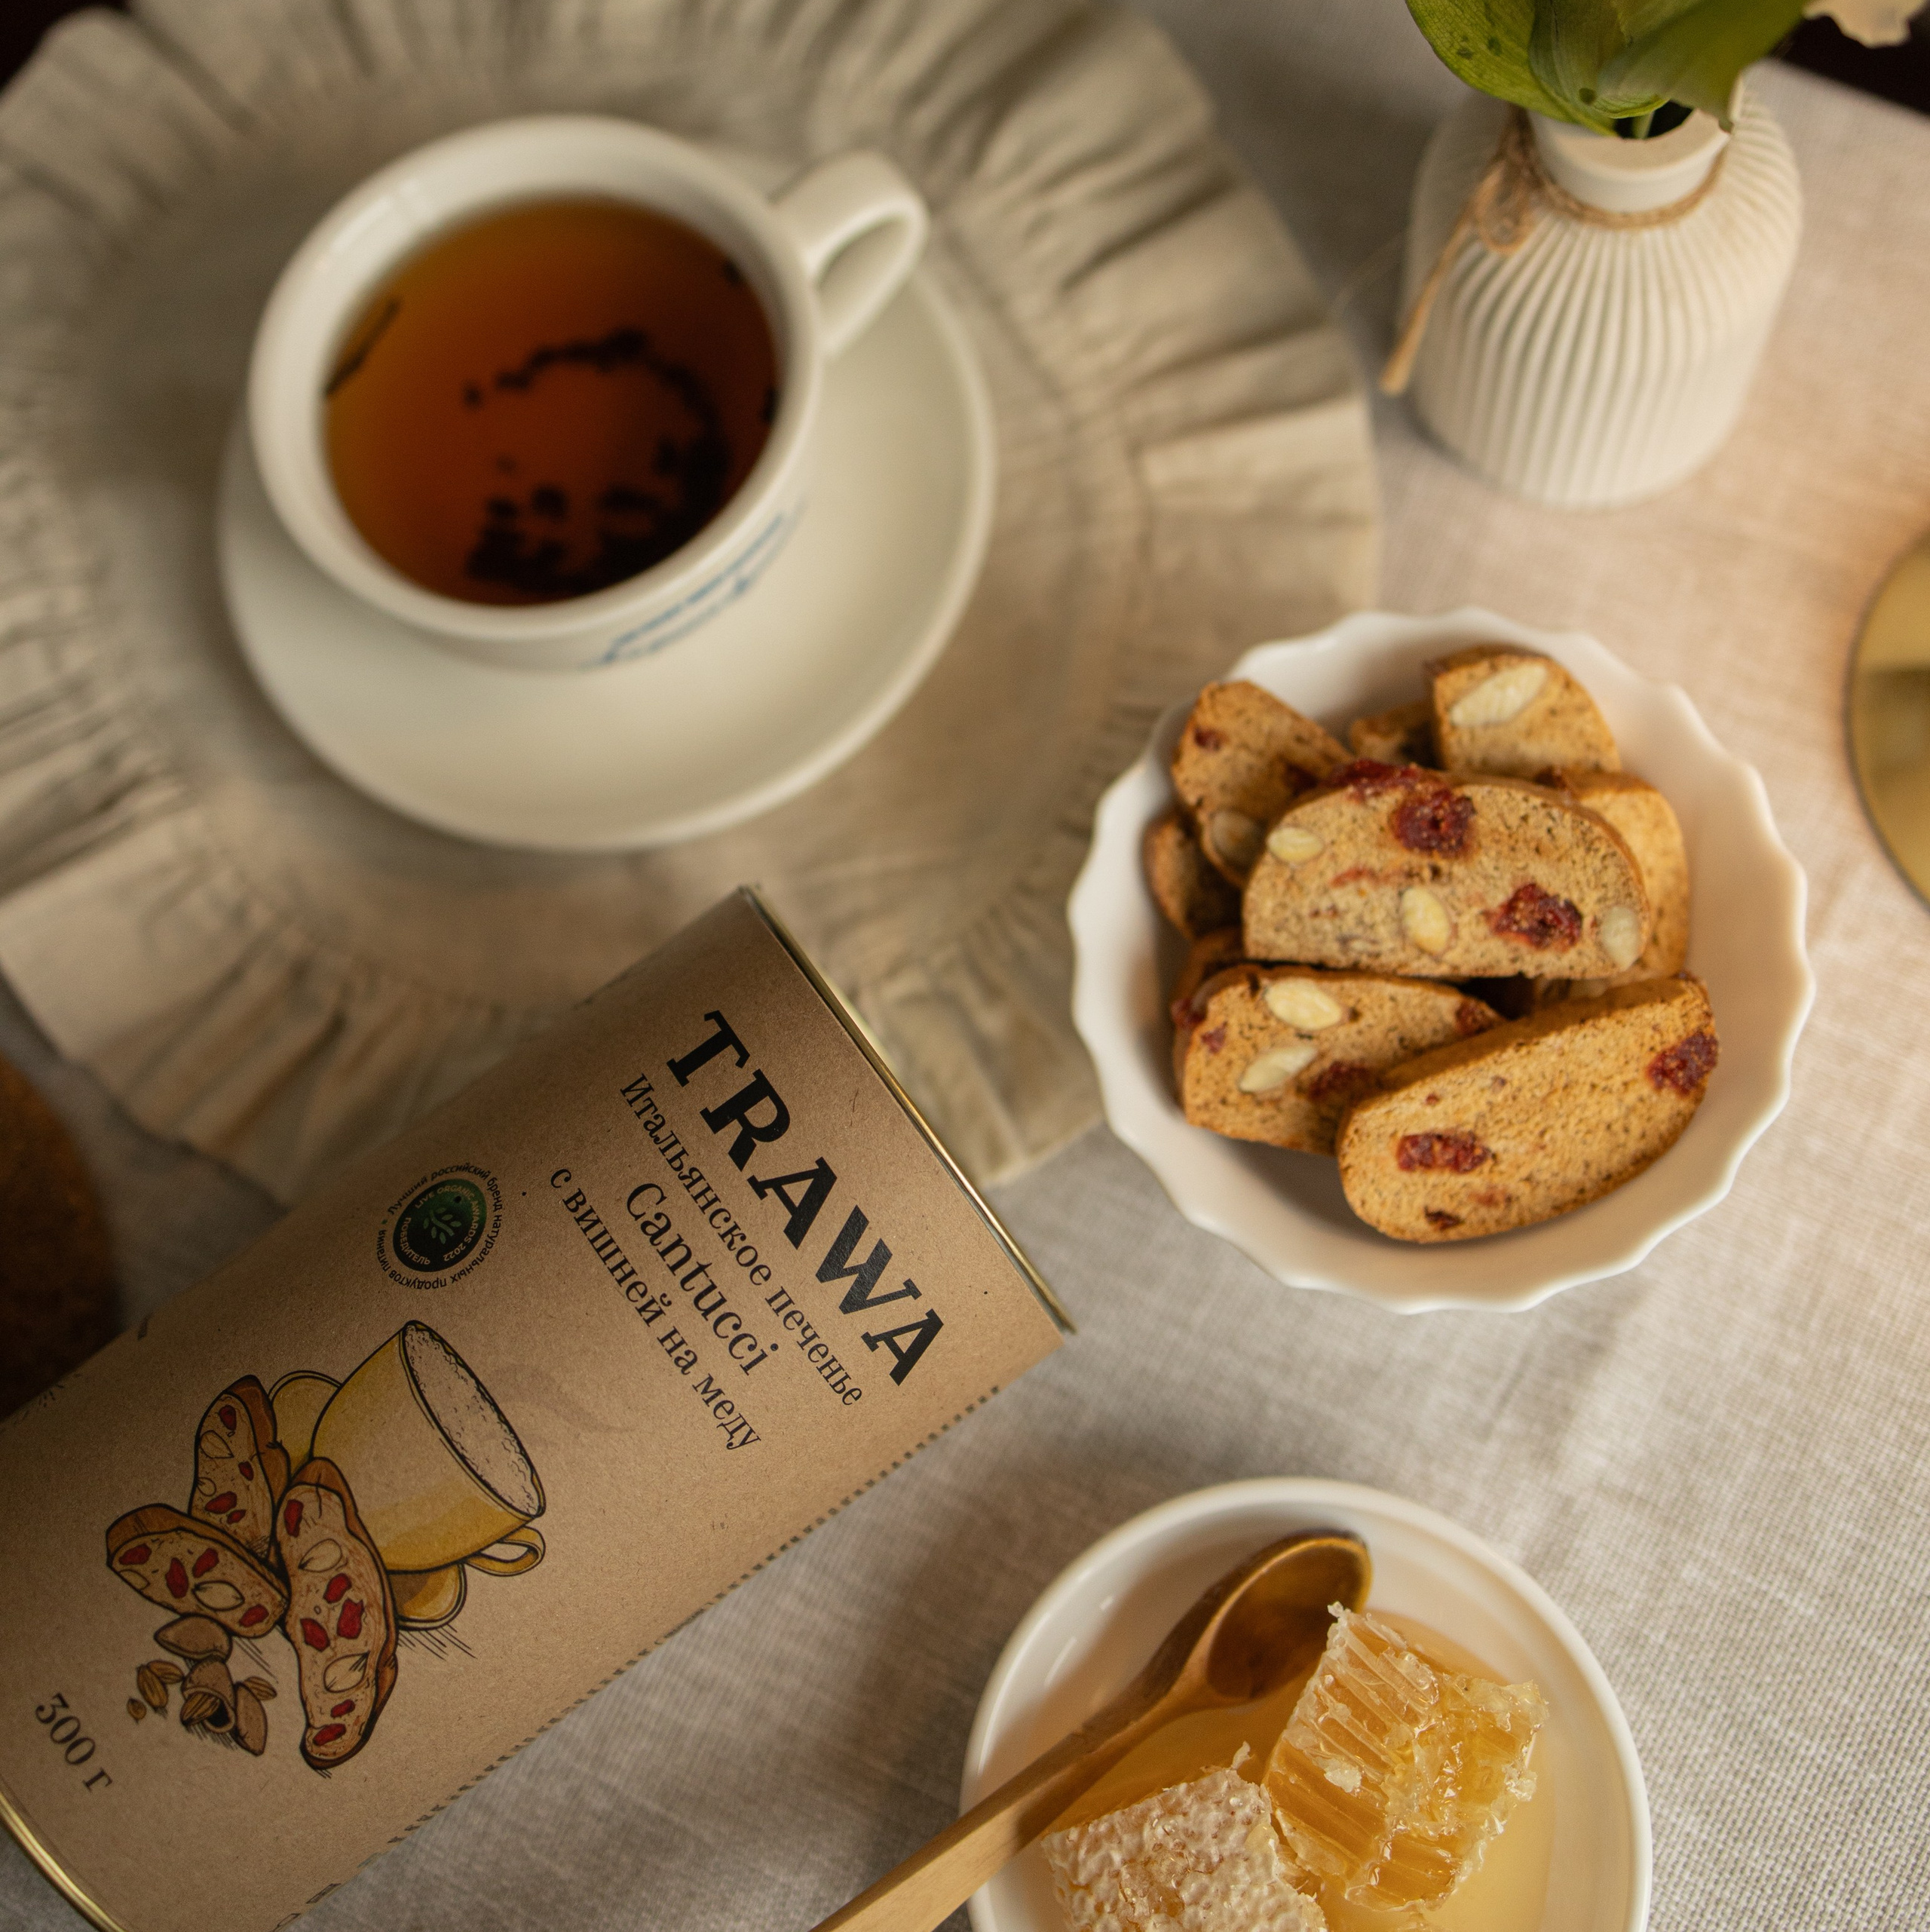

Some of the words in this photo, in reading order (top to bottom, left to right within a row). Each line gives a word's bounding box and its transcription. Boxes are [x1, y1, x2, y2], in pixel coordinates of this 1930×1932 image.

[430, 1162, 492, 1181] российский
[437, 1184, 476, 1201] ORGANIC
[388, 1176, 428, 1215] Лучший
[415, 1191, 436, 1209] LIVE
[487, 1177, 504, 1213] бренд
[666, 1010, 944, 1387] TRAWA
[400, 1216, 431, 1266] ПОБЕДИТЕЛЬ
[464, 1200, 480, 1244] AWARDS
[620, 1073, 771, 1286] Итальянское
[766, 1285, 862, 1406] печенье
[376, 1229, 391, 1272] питания
[443, 1244, 467, 1262] 2022
[450, 1214, 503, 1284] натуральных
[388, 1269, 447, 1290] продуктов
[626, 1182, 779, 1376] Cantucci
[550, 1168, 571, 1189] с
[563, 1188, 671, 1328] вишней
[657, 1327, 694, 1375] на
[693, 1373, 761, 1451] меду
[35, 1692, 96, 1765] 300
[82, 1767, 113, 1793] г
